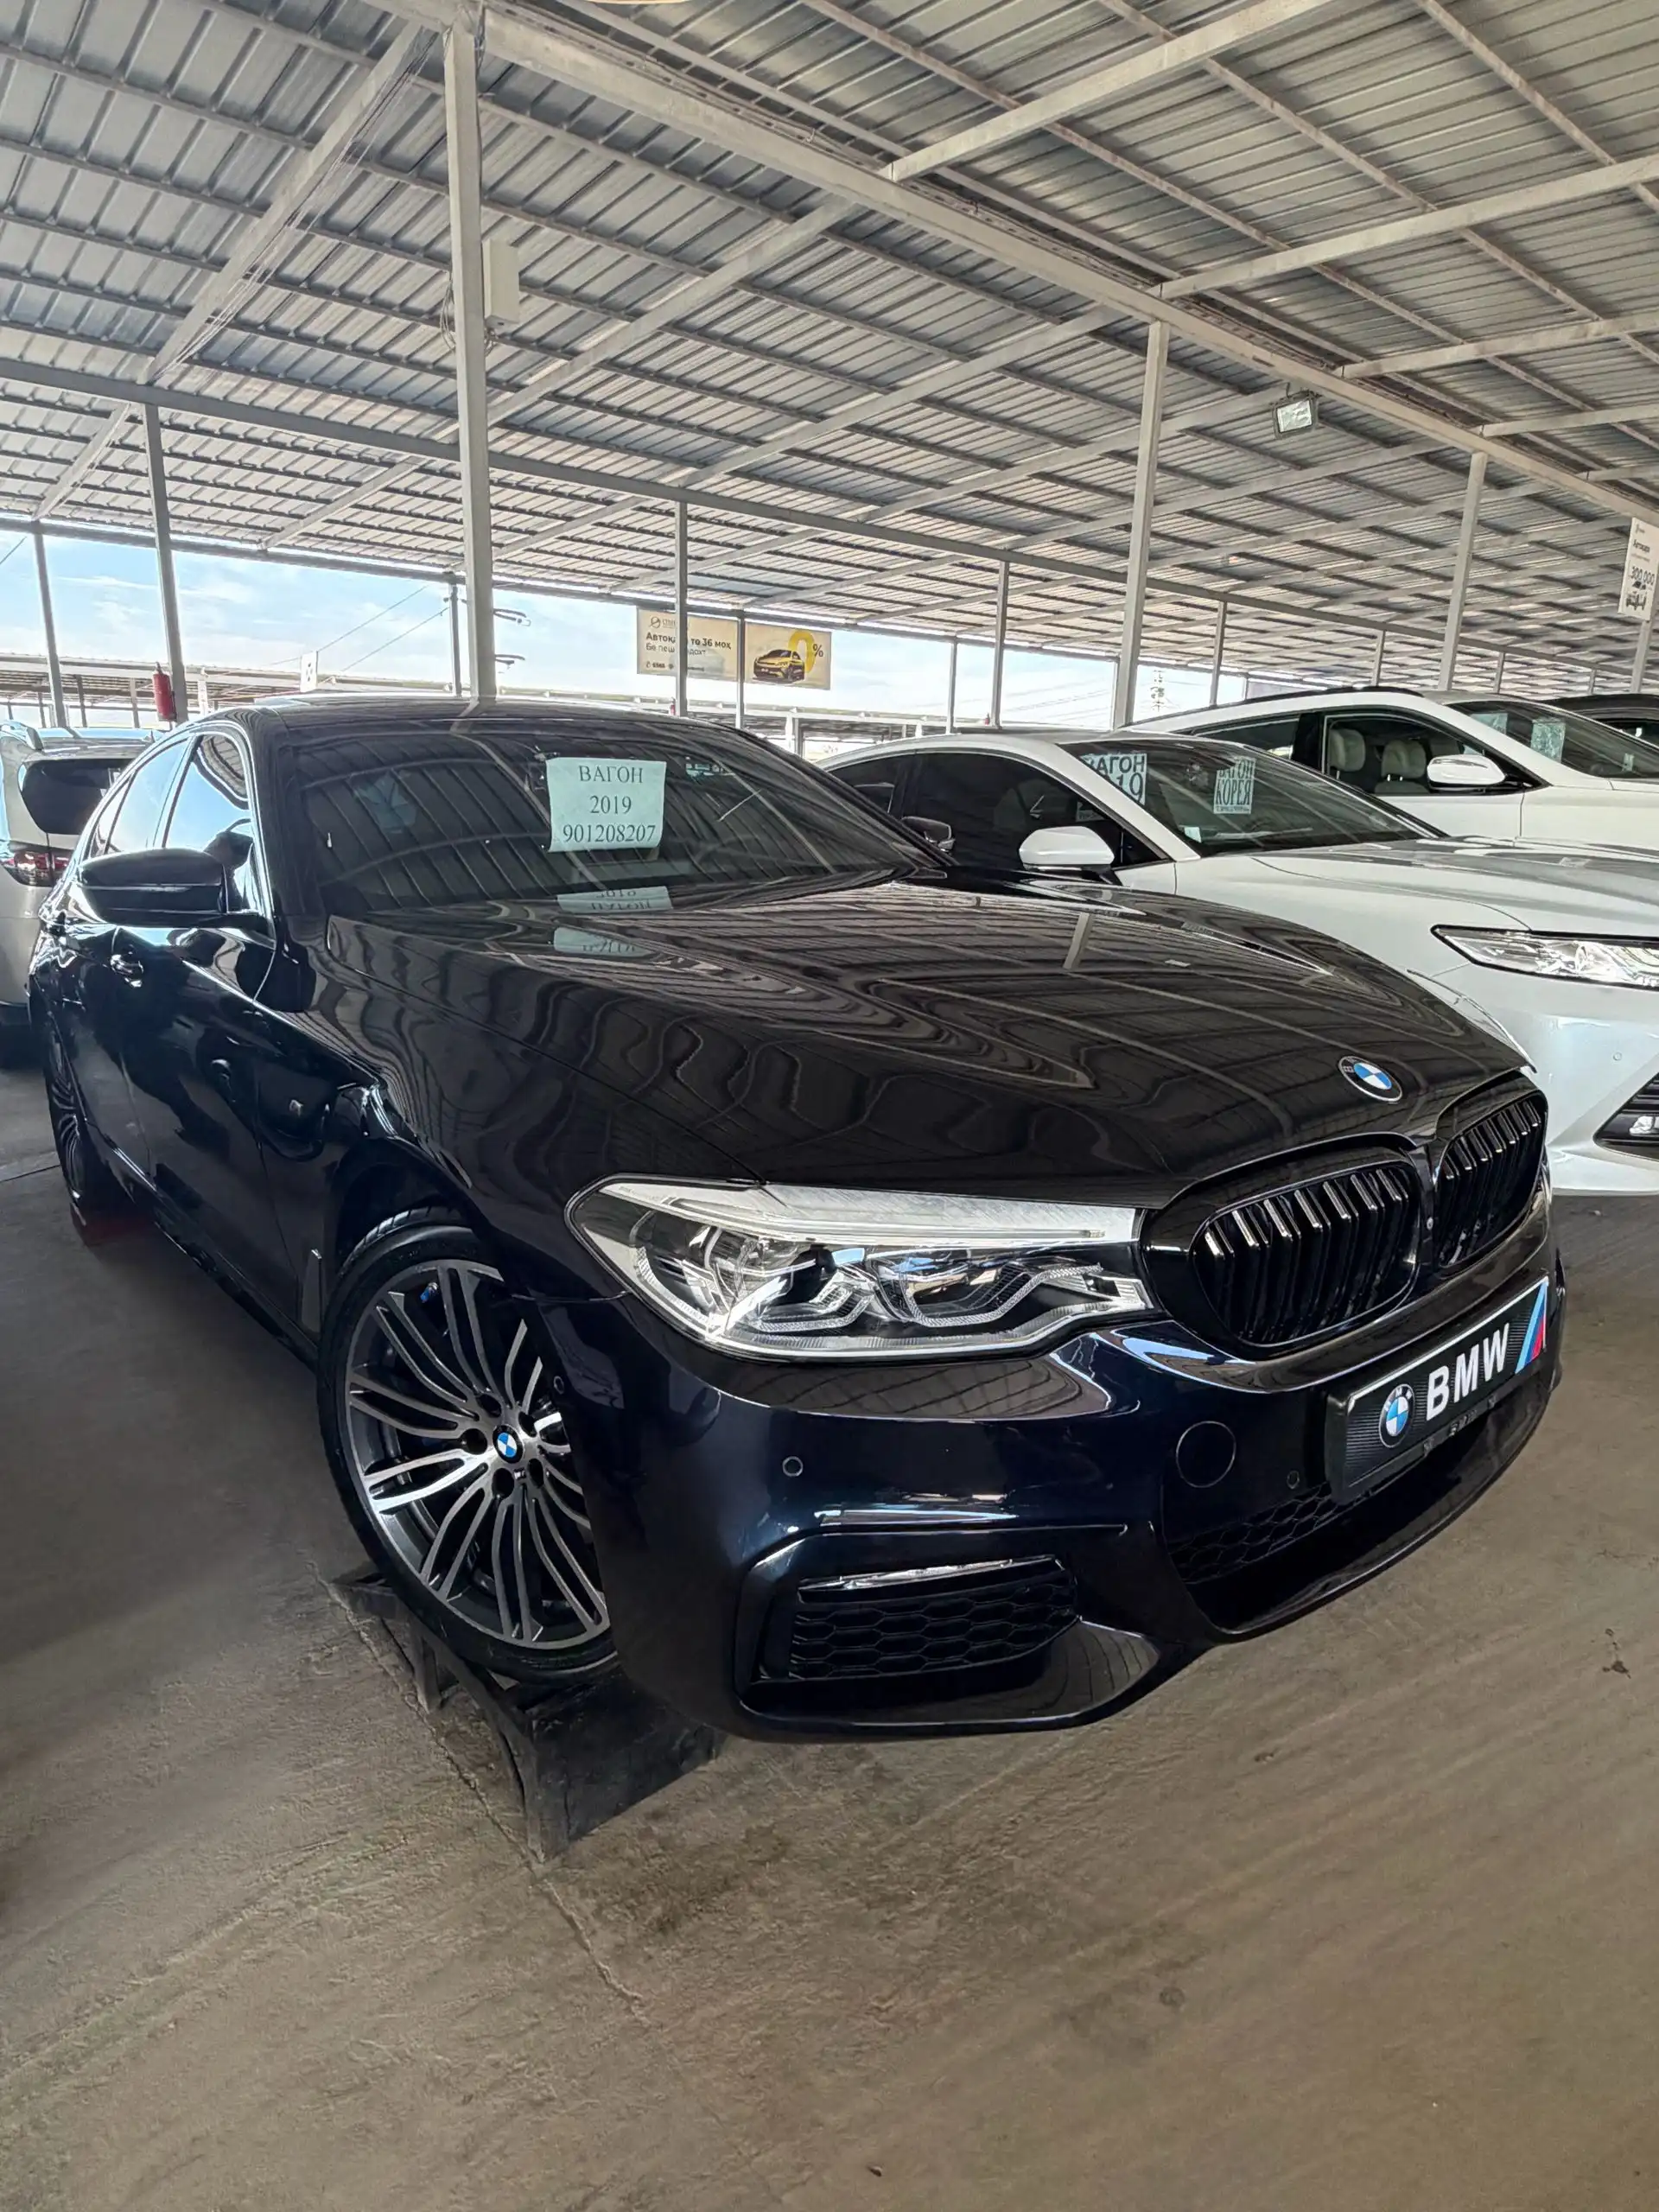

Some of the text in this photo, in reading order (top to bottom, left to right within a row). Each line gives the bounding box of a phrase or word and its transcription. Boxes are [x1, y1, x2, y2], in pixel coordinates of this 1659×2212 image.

[702, 638, 713, 647] 36
[579, 766, 643, 784] ВАГОН
[1116, 772, 1143, 802] 19
[1216, 778, 1251, 805] КОРЕЯ
[589, 795, 632, 814] 2019
[563, 824, 656, 843] 901208207
[1427, 1323, 1510, 1421] BMW
